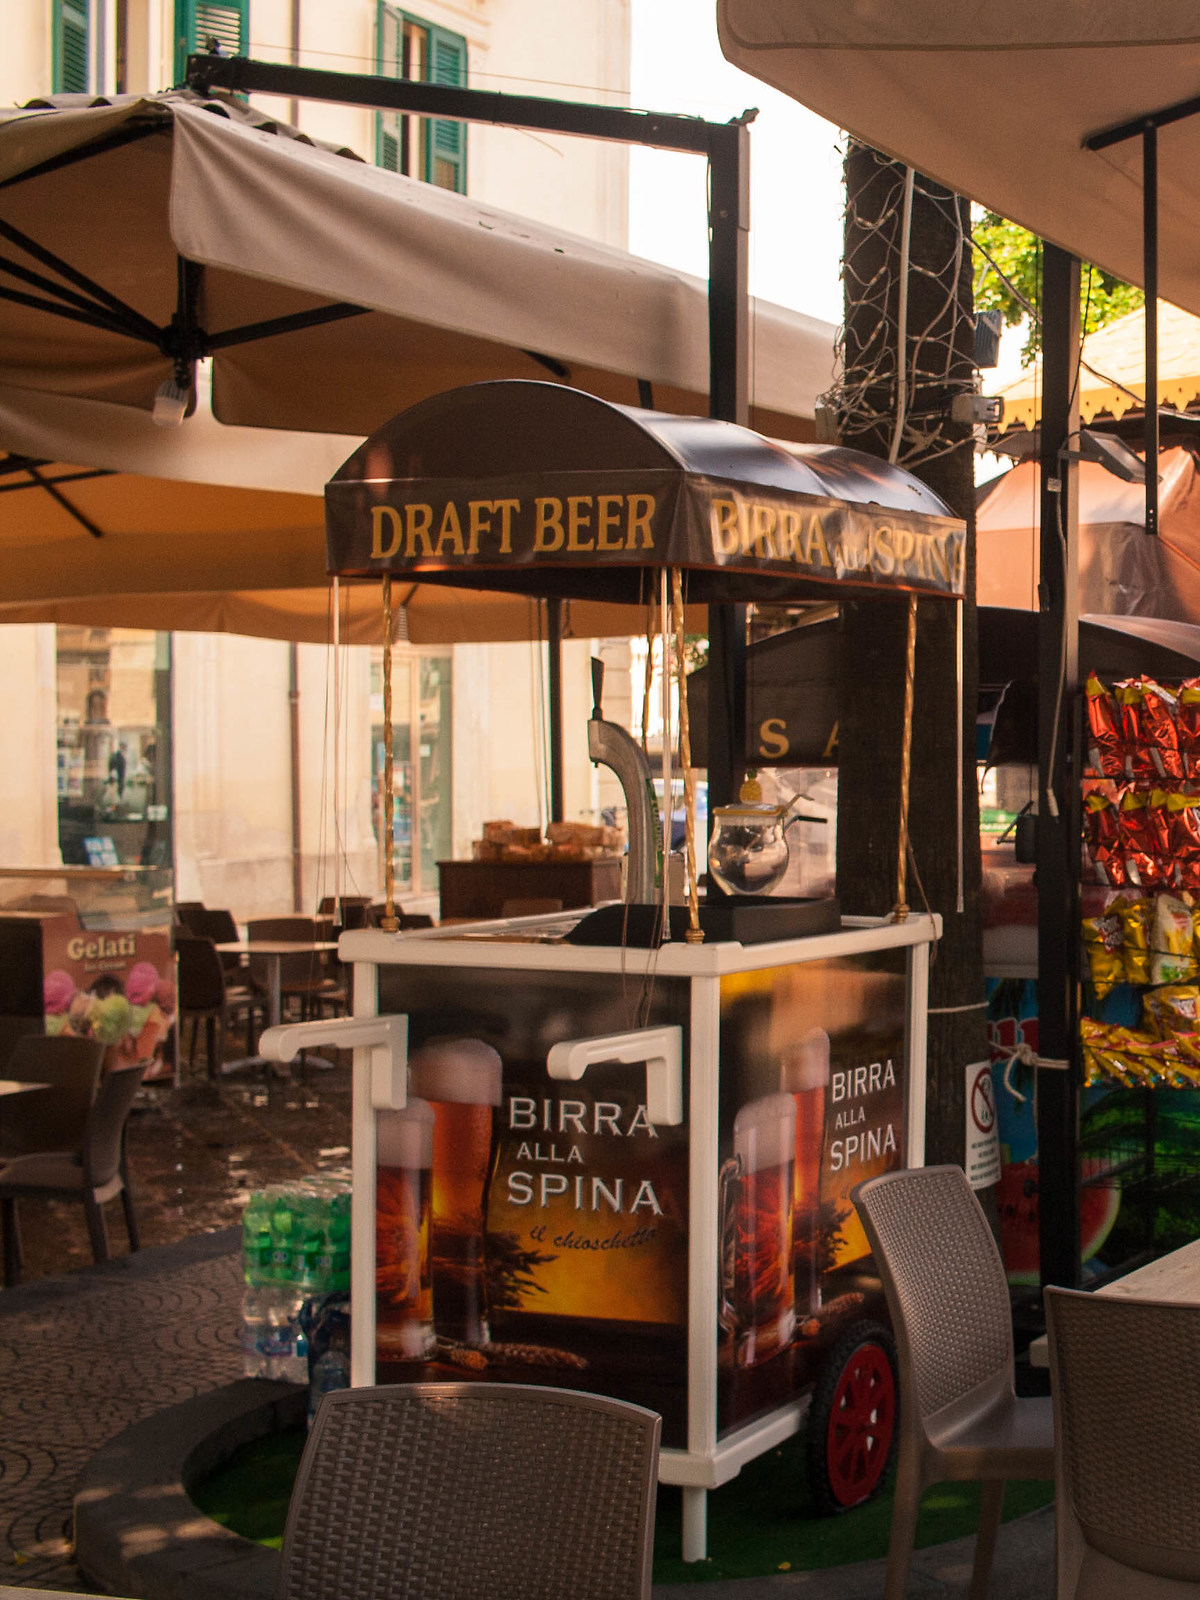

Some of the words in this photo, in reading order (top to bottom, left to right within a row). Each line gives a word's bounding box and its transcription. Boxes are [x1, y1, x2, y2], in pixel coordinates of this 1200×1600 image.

[370, 499, 521, 559] DRAFT
[532, 495, 657, 552] BEER
[711, 499, 832, 567] BIRRA
[874, 525, 967, 584] SPINA
[68, 934, 136, 960] Gelati
[832, 1059, 897, 1104] BIRRA
[509, 1096, 659, 1139] BIRRA
[835, 1106, 866, 1130] ALLA
[516, 1141, 585, 1164] ALLA
[829, 1124, 897, 1173] SPINA
[507, 1170, 664, 1216] SPINA
[529, 1225, 547, 1243] il
